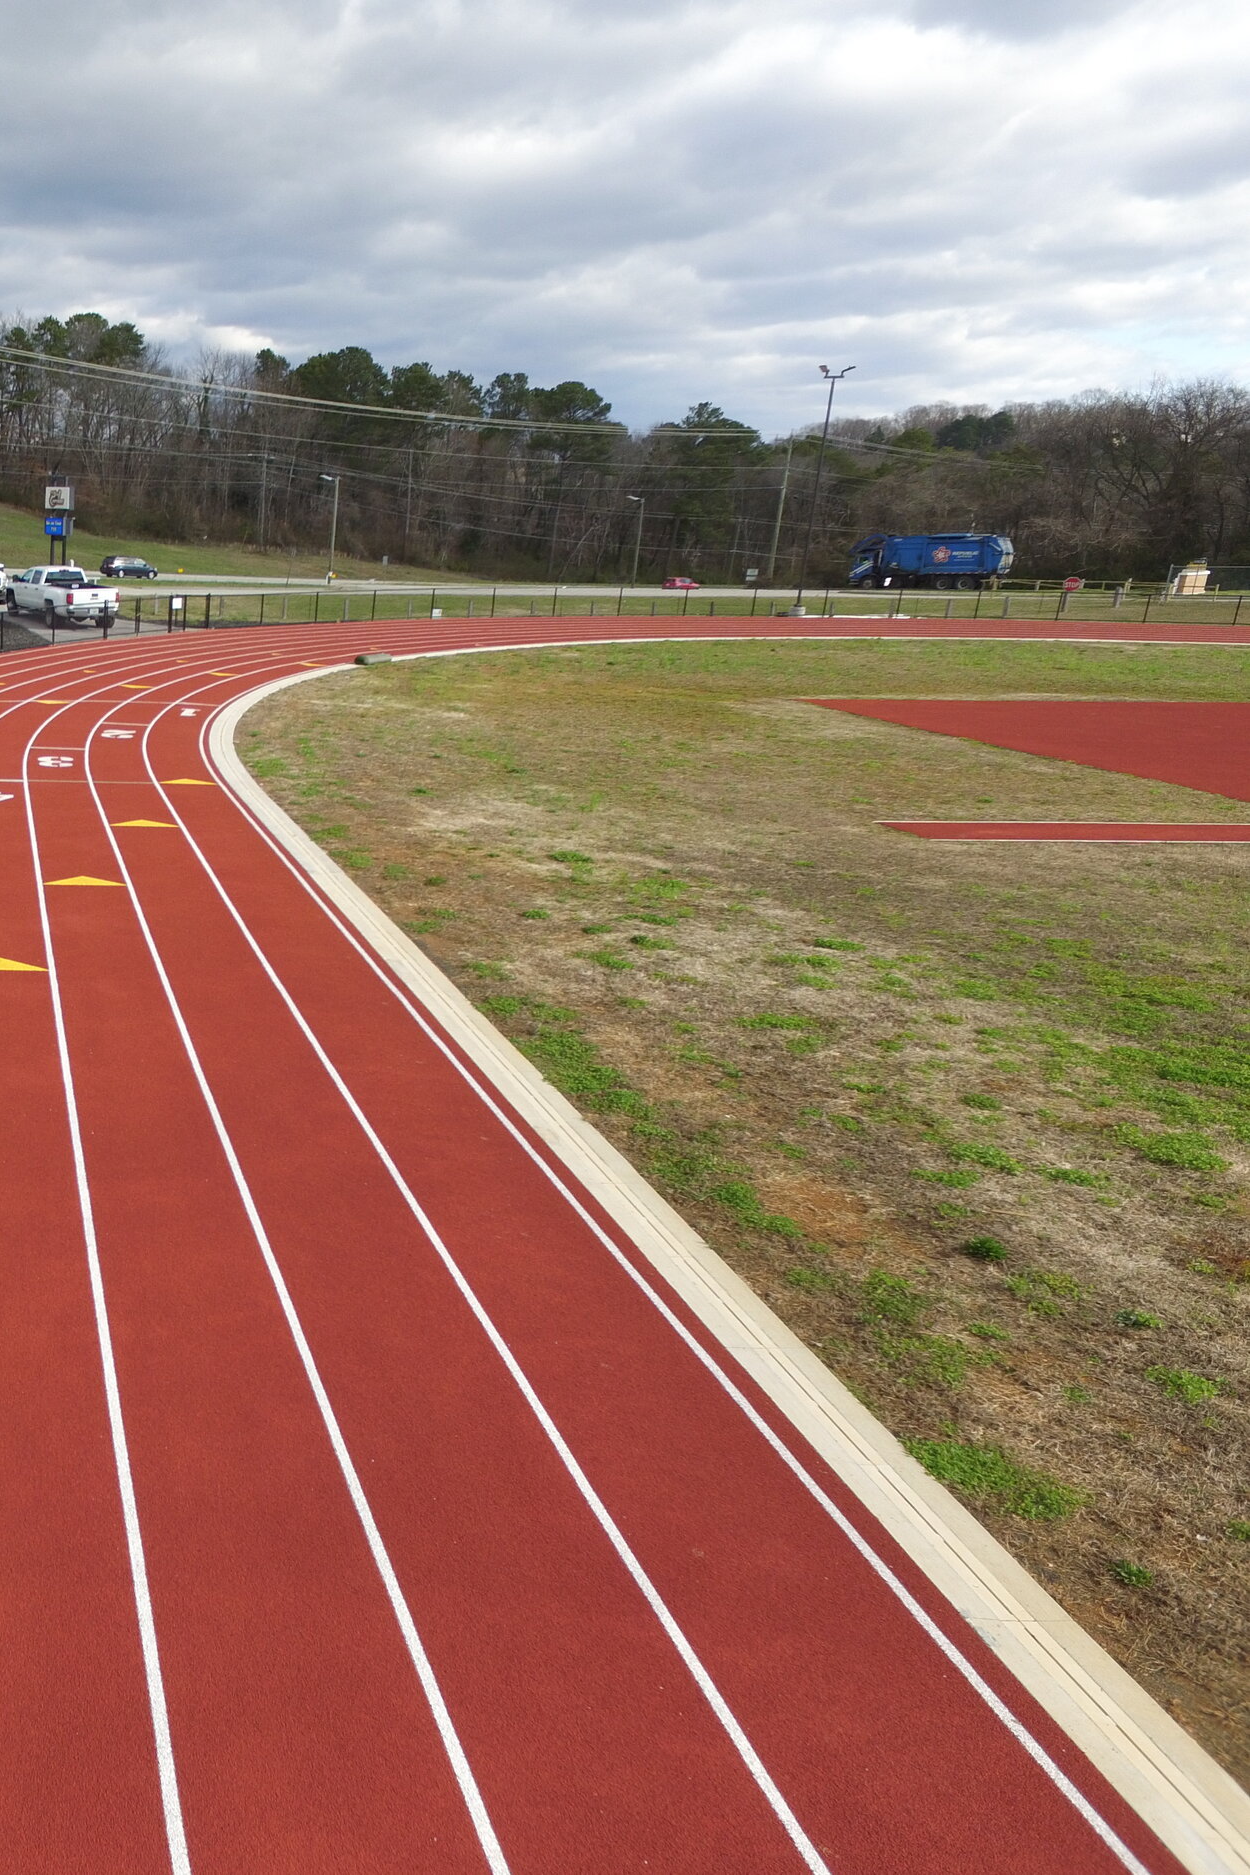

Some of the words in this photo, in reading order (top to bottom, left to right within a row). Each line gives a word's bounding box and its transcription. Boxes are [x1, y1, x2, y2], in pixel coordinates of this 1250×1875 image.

[179, 707, 201, 717] 1
[100, 728, 137, 739] 2
[37, 755, 74, 768] 3
